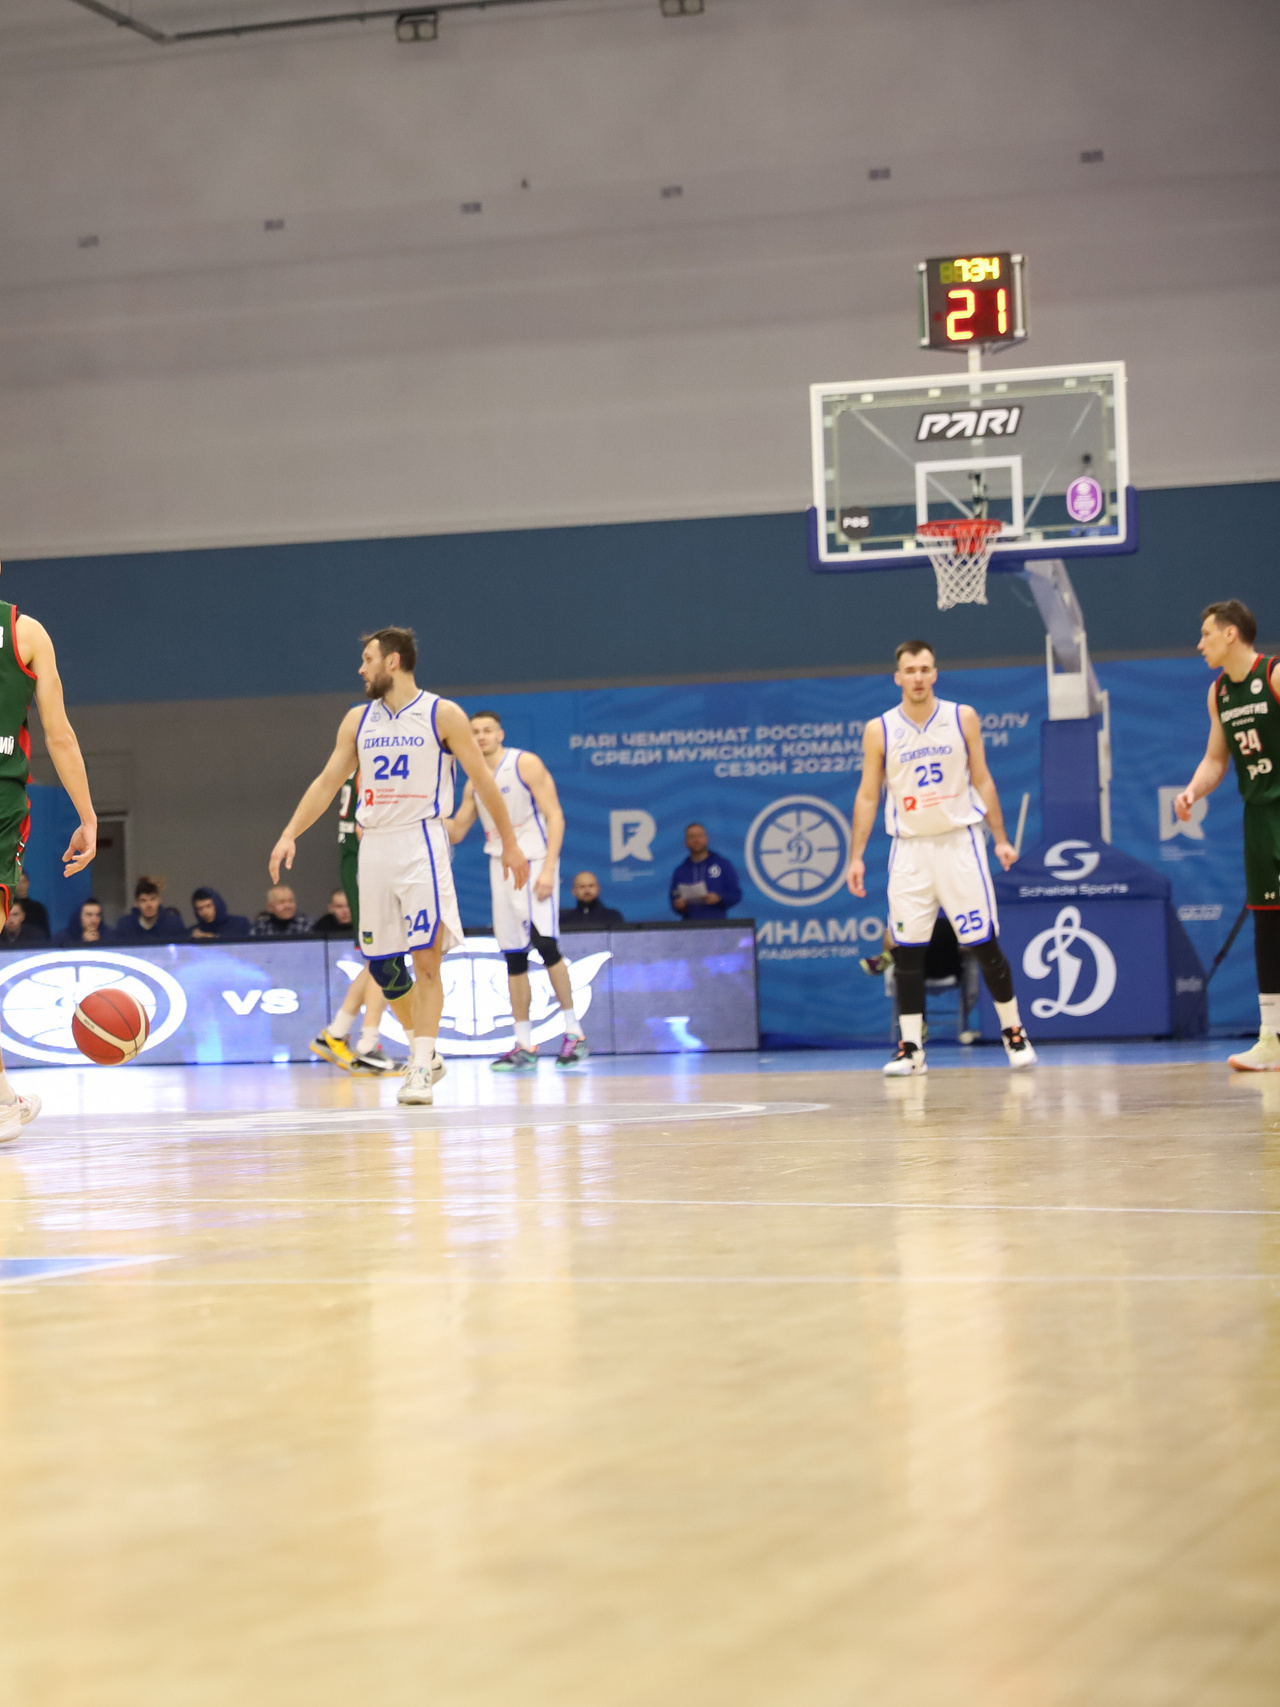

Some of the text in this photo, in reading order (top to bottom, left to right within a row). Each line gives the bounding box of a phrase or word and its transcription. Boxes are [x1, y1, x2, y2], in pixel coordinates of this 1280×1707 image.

[946, 288, 1007, 340] 21
[917, 407, 1020, 440] PARI
[363, 736, 425, 750] ДИНАМО
[621, 728, 749, 747] ЧЕМПИОНАТ
[756, 723, 843, 741] РОССИИ
[848, 721, 866, 737] П
[590, 749, 662, 766] СРЕДИ
[666, 743, 775, 763] МУЖСКИХ
[781, 738, 863, 758] КОМАН
[373, 754, 410, 780] 24
[714, 757, 864, 778] СЕЗОН 2022/2
[915, 763, 943, 788] 25
[756, 917, 884, 945] ИНАМО
[955, 910, 983, 935] 25
[759, 946, 859, 960] ЛАДИВОСТОК
